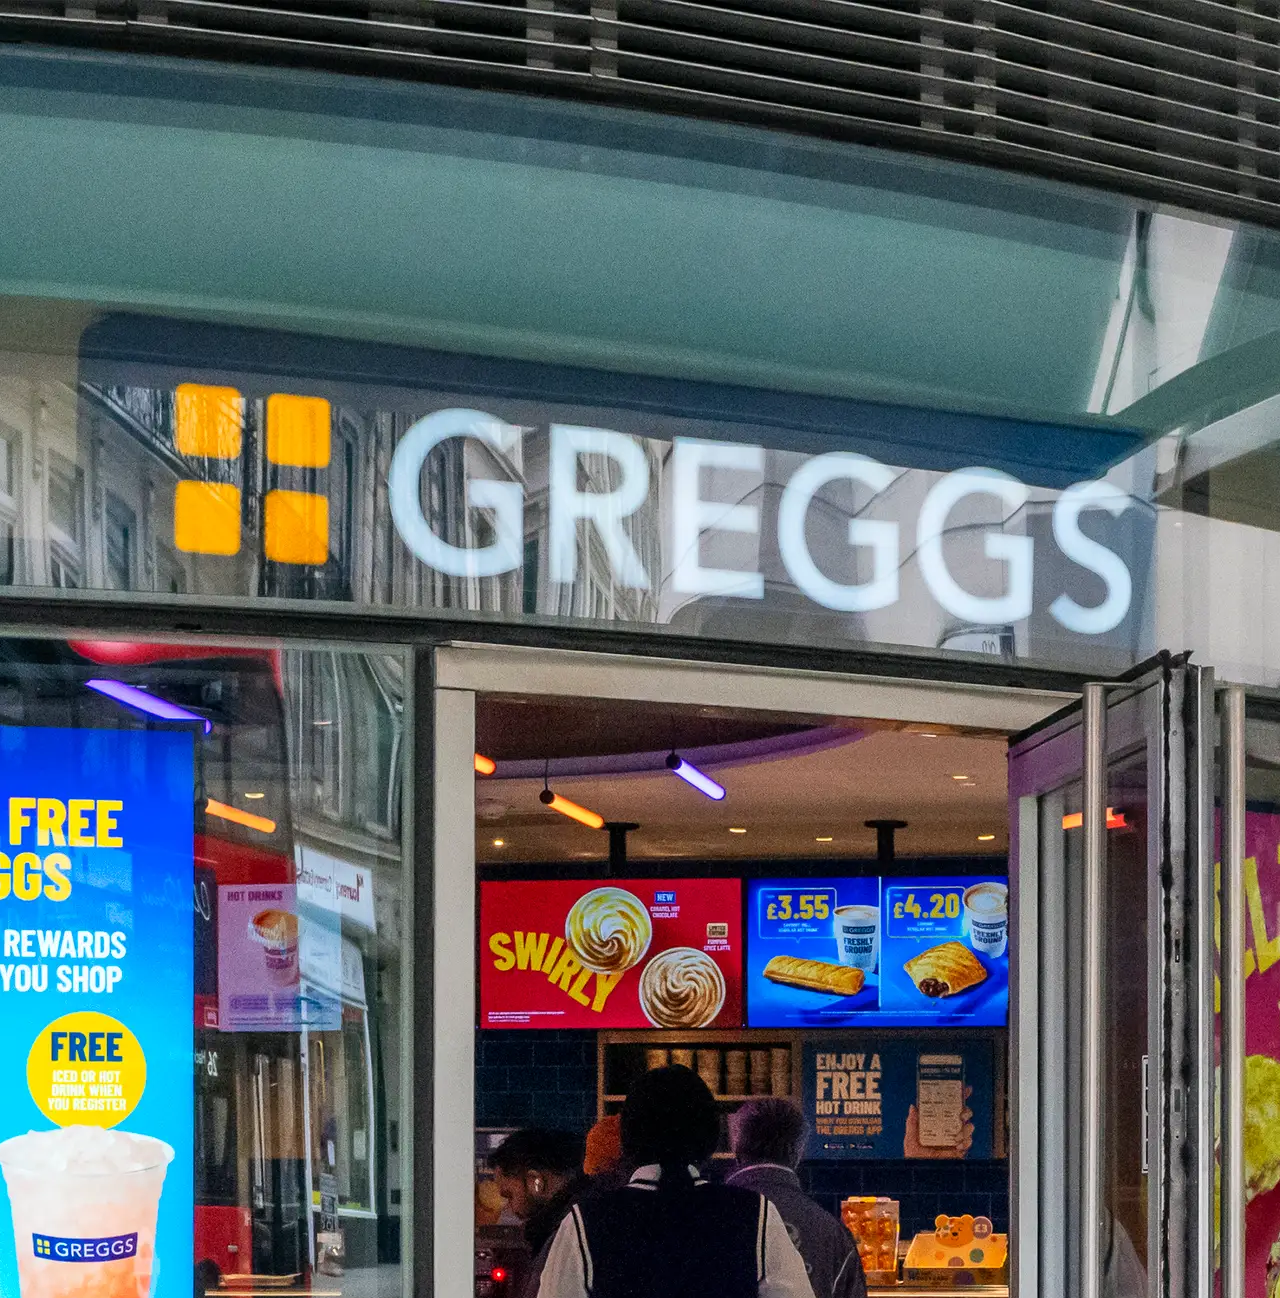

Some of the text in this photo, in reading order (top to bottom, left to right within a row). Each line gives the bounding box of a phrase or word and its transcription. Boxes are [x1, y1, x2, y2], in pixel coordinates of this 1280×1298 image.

[387, 406, 1132, 636] GREGGS
[9, 796, 124, 847] FREE
[227, 890, 283, 901] HOT DRINKS
[767, 895, 829, 920] £3.55
[893, 893, 960, 919] £4.20
[3, 930, 127, 959] REWARDS
[843, 937, 874, 945] FRESHLY
[844, 945, 872, 954] GROUND
[56, 964, 122, 993] SHOP
[489, 931, 625, 1013] SWIRLY
[51, 1031, 123, 1062] FREE
[816, 1053, 881, 1070] ENJOY A
[53, 1070, 120, 1082] ICED OR HOT
[816, 1071, 882, 1100] FREE
[51, 1084, 122, 1096] DRINK WHEN
[48, 1098, 126, 1110] YOU REGISTER
[816, 1101, 881, 1114] HOT DRINK
[974, 1225, 988, 1233] £3
[54, 1238, 134, 1258] GREGGS
